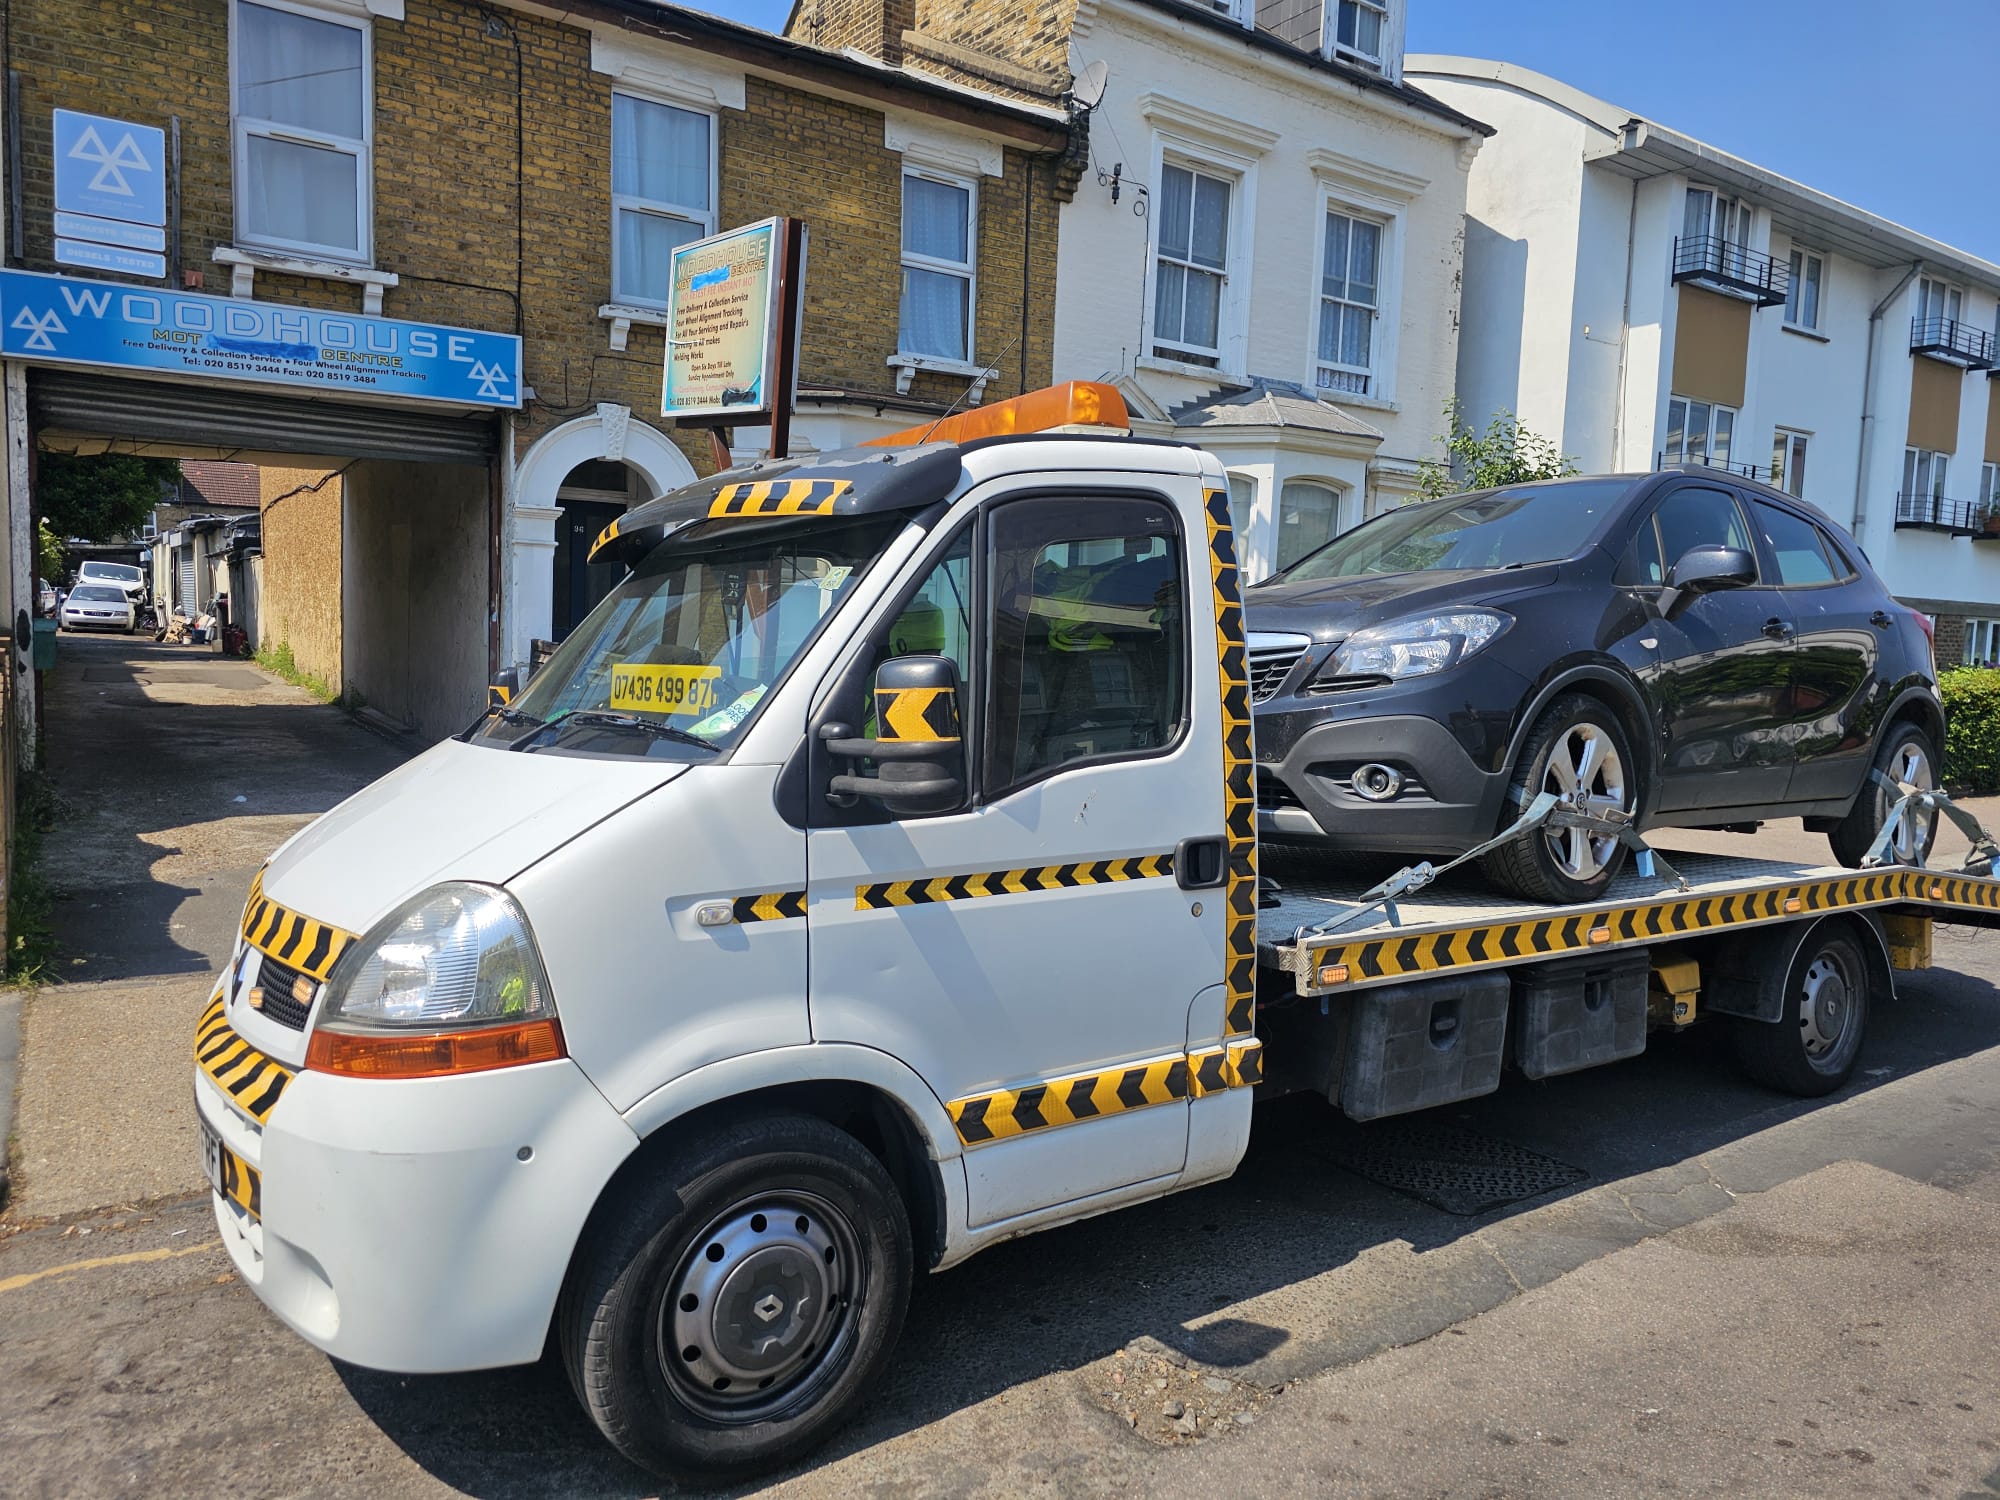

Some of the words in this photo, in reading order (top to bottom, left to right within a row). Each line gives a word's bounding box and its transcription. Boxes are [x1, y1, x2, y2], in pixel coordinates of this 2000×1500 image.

[678, 238, 768, 280] WOODHOUSE
[731, 259, 766, 277] CENTRE
[708, 296, 731, 308] Collection
[731, 293, 749, 304] Service
[60, 285, 476, 363] WOODHOUSE
[698, 324, 719, 335] Servicing
[719, 322, 729, 330] and
[699, 311, 722, 323] Alignment
[722, 308, 743, 318] Tracking
[122, 339, 144, 348] Free
[147, 342, 187, 354] Delivery
[201, 348, 247, 360] Collection
[249, 354, 282, 365] Service
[293, 359, 313, 368] Four
[315, 361, 343, 371] Wheel
[345, 364, 389, 376] Alignment
[391, 370, 426, 381] Tracking
[153, 328, 202, 345] MOT
[321, 348, 403, 368] CENTRE
[183, 357, 200, 366] Tel:
[204, 360, 223, 368] 020
[227, 362, 252, 371] 8519
[255, 365, 280, 374] 3444
[283, 368, 303, 377] Fax:
[306, 370, 324, 379] 020
[327, 373, 350, 382] 8519
[353, 375, 376, 384] 3484
[614, 674, 653, 702] 07436
[655, 676, 684, 703] 499
